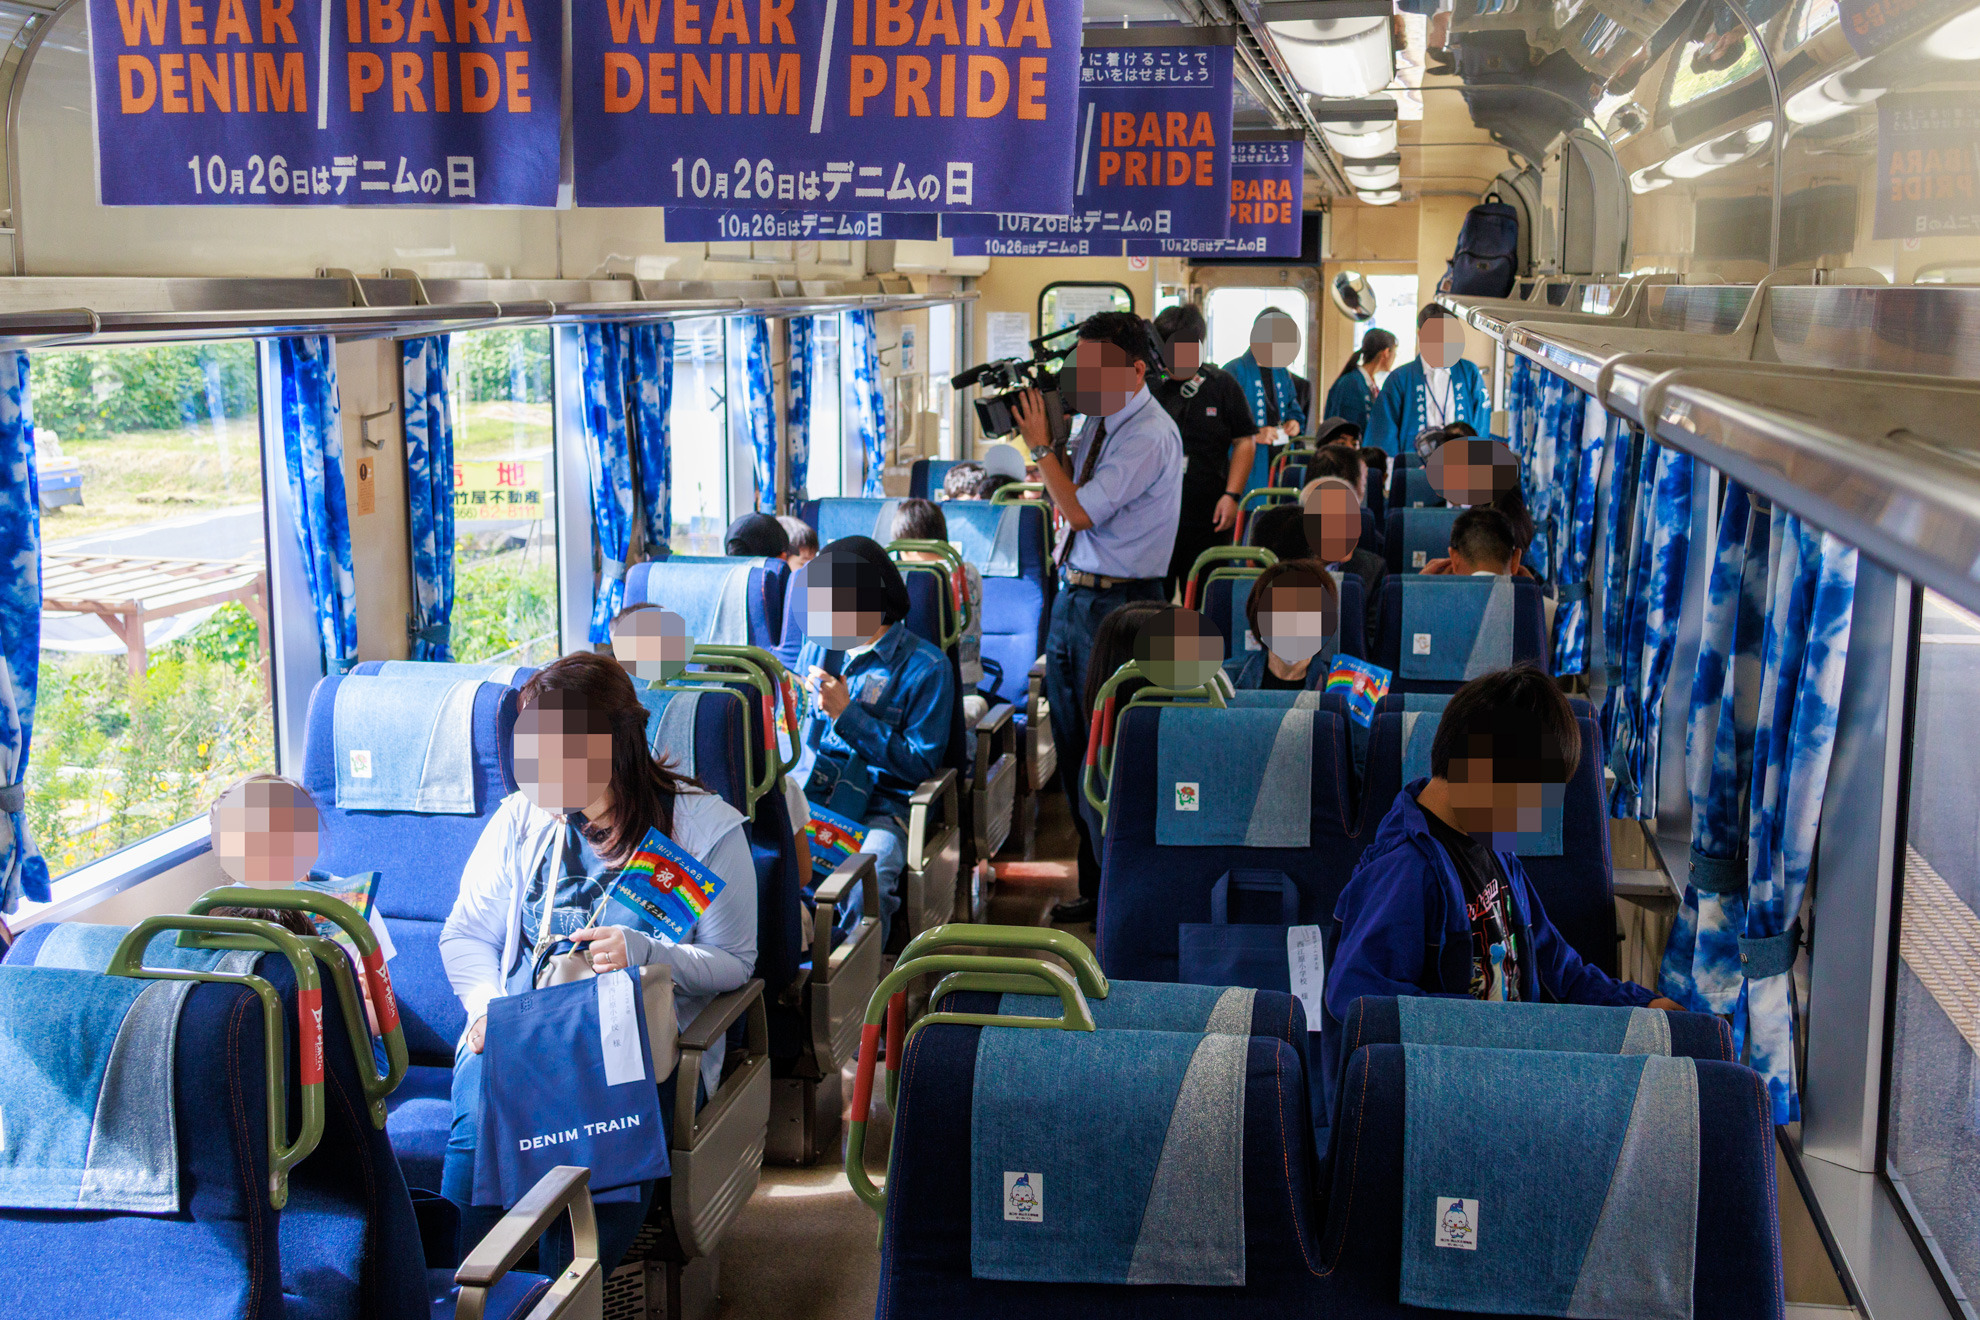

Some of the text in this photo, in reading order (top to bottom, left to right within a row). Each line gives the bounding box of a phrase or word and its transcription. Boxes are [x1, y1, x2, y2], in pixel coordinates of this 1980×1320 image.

[116, 0, 532, 46] WEAR IBARA
[606, 0, 1052, 48] WEAR IBARA
[118, 52, 532, 114] DENIM PRIDE
[603, 52, 1047, 120] DENIM PRIDE
[1081, 67, 1209, 82] 思いをはせましょう
[1100, 111, 1216, 147] IBARA
[188, 154, 477, 198] 10月26日はデニムの日
[671, 157, 974, 206] 10月26日はデニムの日
[1099, 151, 1214, 186] PRIDE
[717, 212, 883, 238] 10月26日はデニムの日
[984, 239, 1090, 255] 10月26日はデニムの日
[656, 867, 675, 889] 祝
[519, 1114, 641, 1151] DENIM TRAIN
